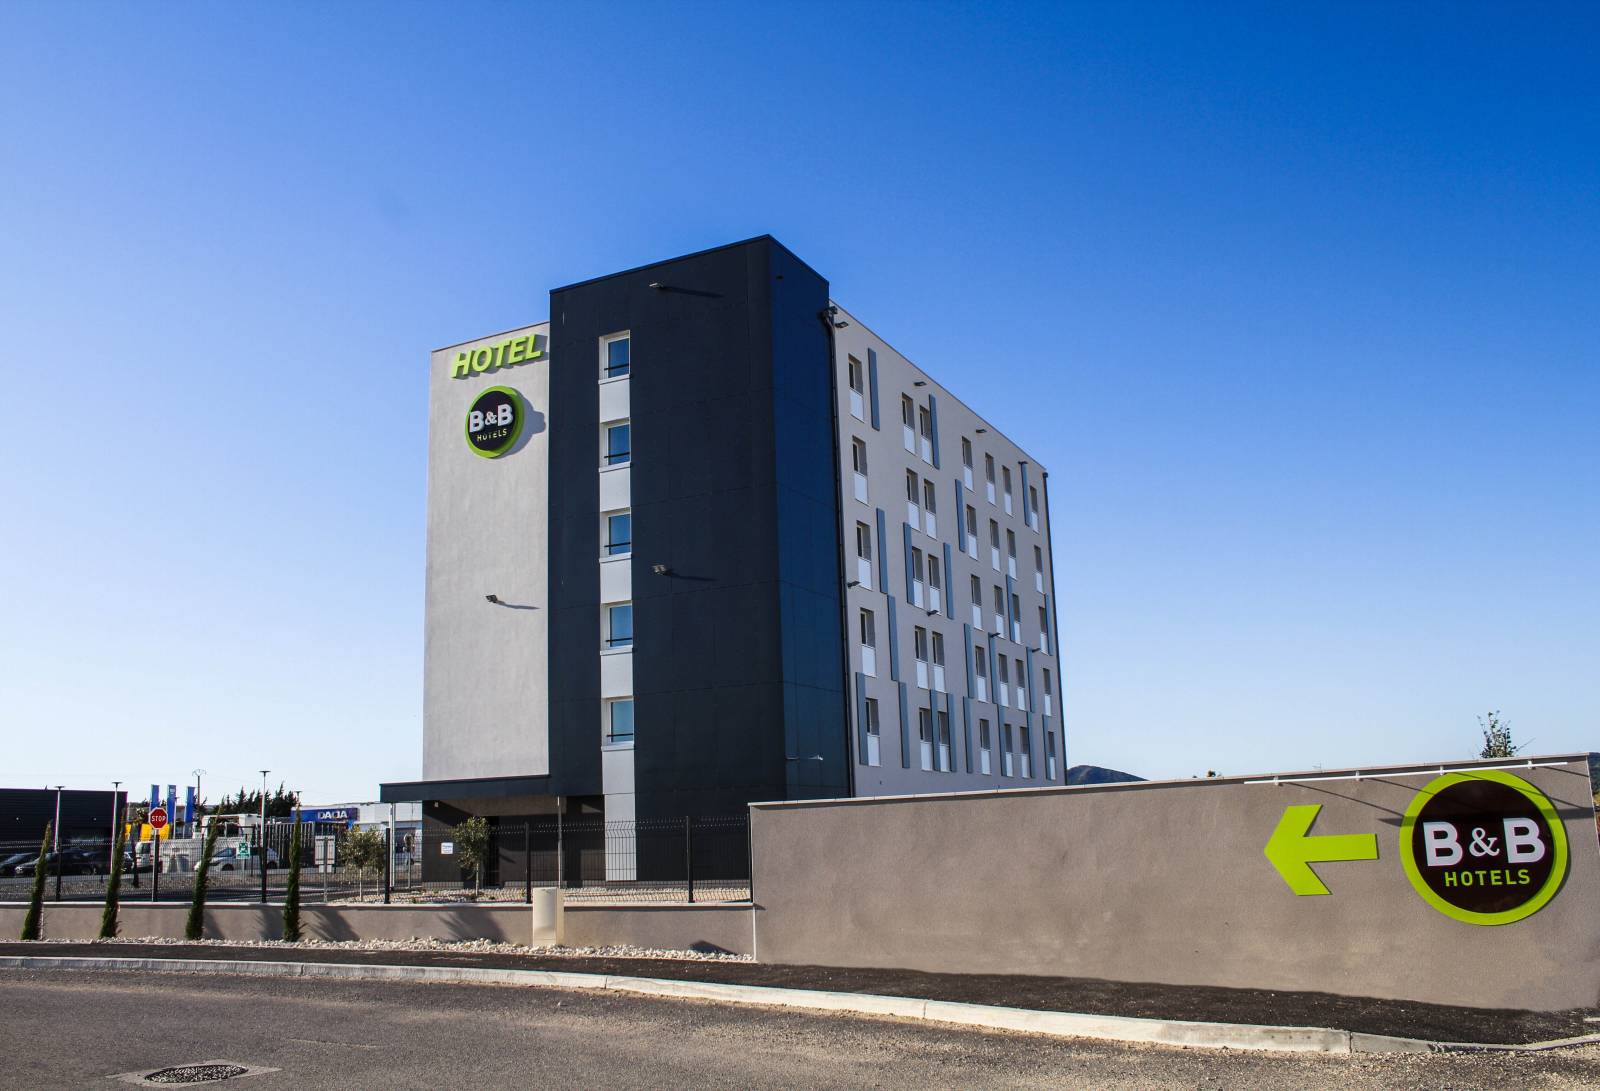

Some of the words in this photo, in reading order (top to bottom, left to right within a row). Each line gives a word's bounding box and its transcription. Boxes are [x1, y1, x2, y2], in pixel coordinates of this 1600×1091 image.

[450, 333, 543, 378] HOTEL
[469, 403, 513, 433] B&B
[476, 428, 508, 441] HOTELS
[1423, 817, 1546, 867] B&B
[1444, 869, 1531, 887] HOTELS
